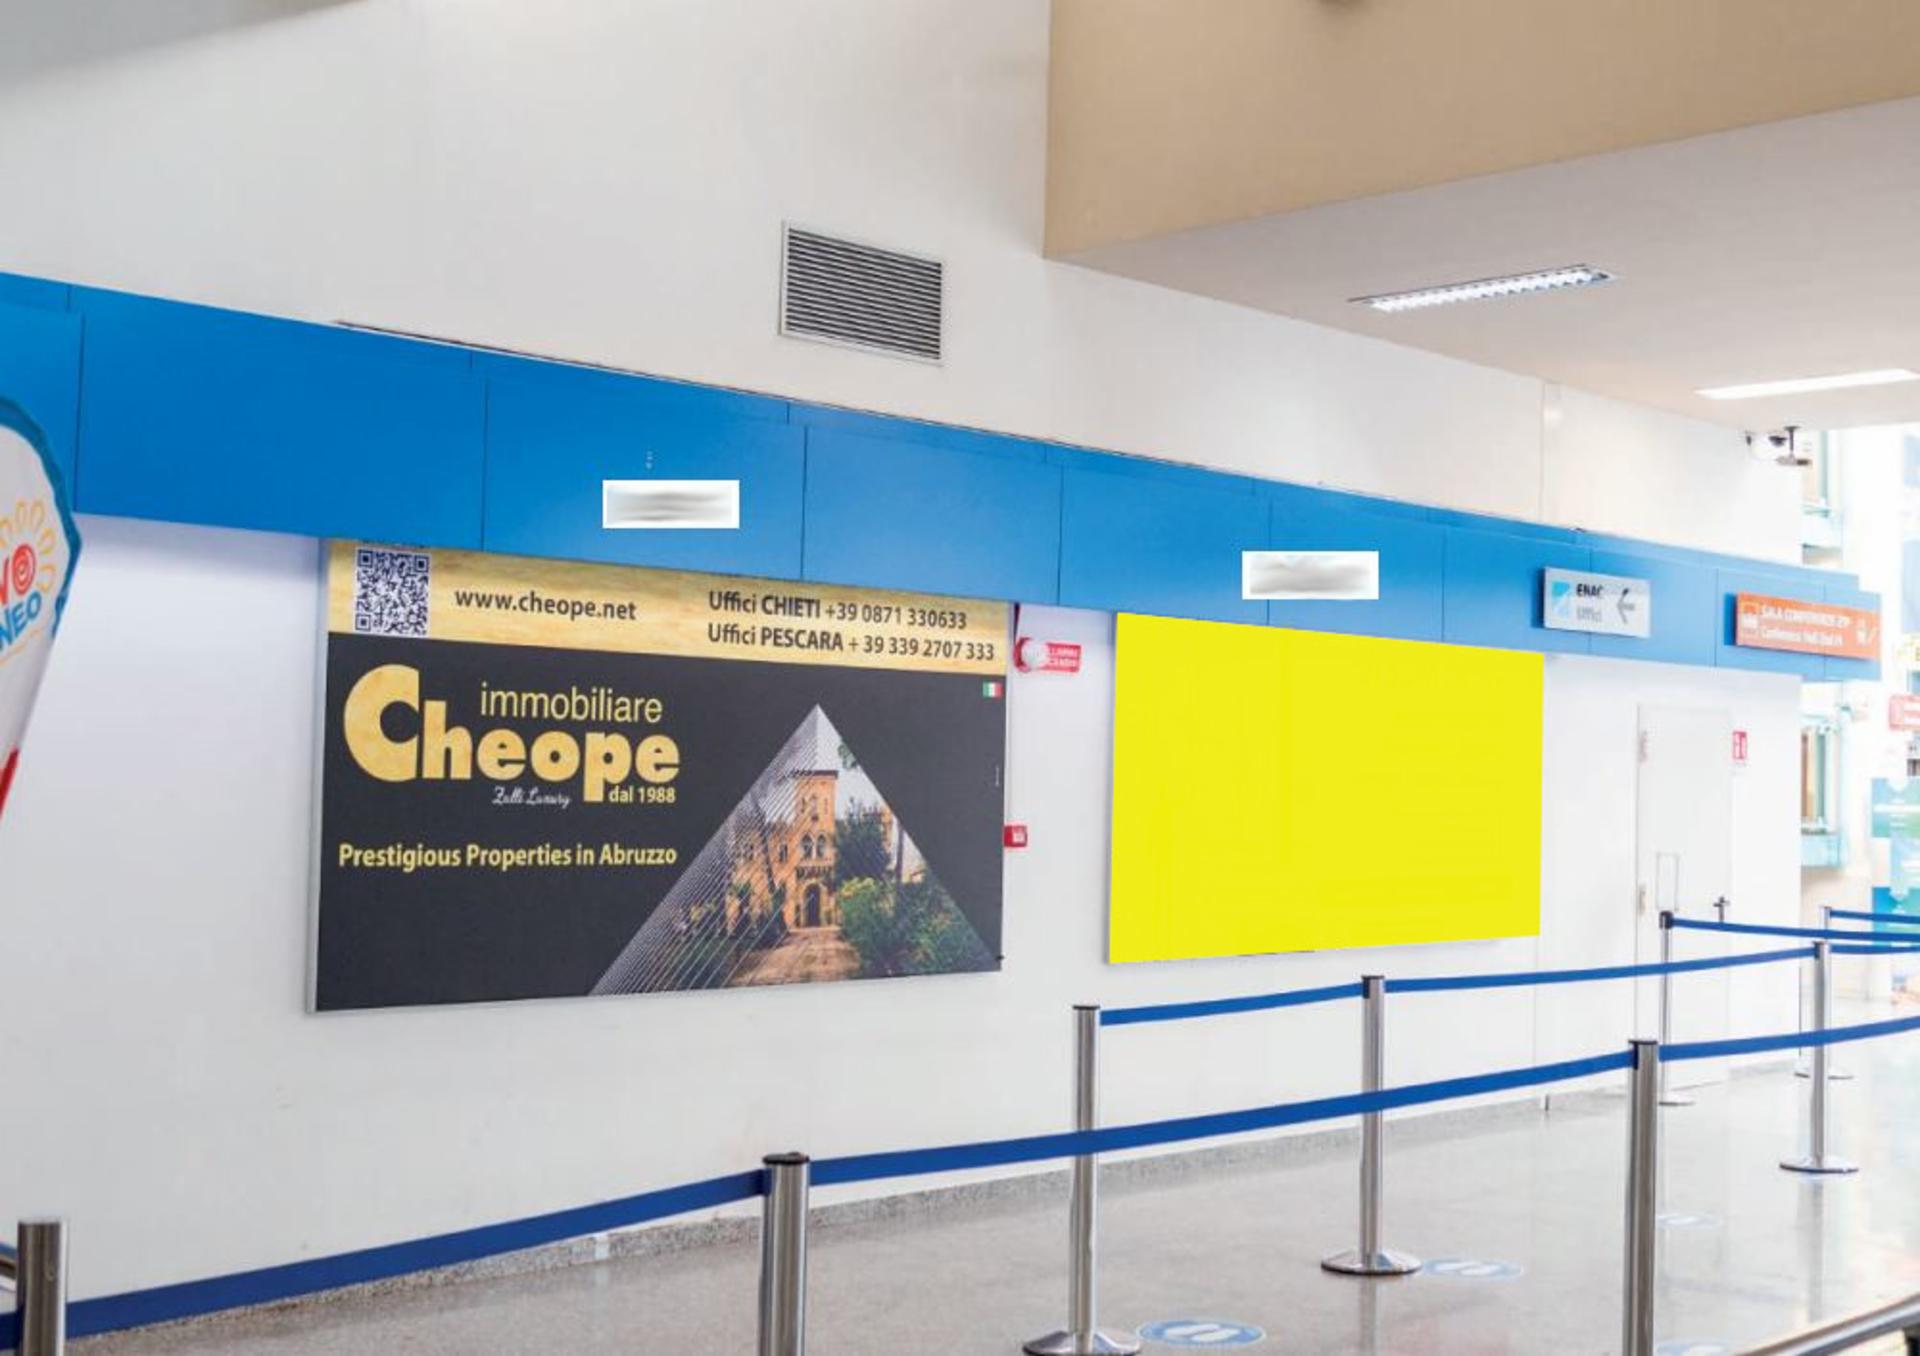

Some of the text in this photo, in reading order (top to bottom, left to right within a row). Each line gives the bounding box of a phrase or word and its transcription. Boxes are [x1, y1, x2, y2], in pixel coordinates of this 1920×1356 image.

[454, 589, 638, 621] www.cheope.net
[708, 590, 967, 630] Uffici CHIETI +39 0871 330633
[707, 622, 757, 646] Uffici
[760, 626, 844, 652] PESCARA
[862, 635, 884, 654] 39
[888, 637, 919, 656] 339
[922, 640, 962, 658] 2707
[965, 642, 995, 661] 333
[480, 682, 663, 724] immobiliare
[343, 663, 681, 804] Cheope
[608, 785, 676, 804] dal 1988
[338, 842, 677, 873] Prestigious Properties in Abruzzo
